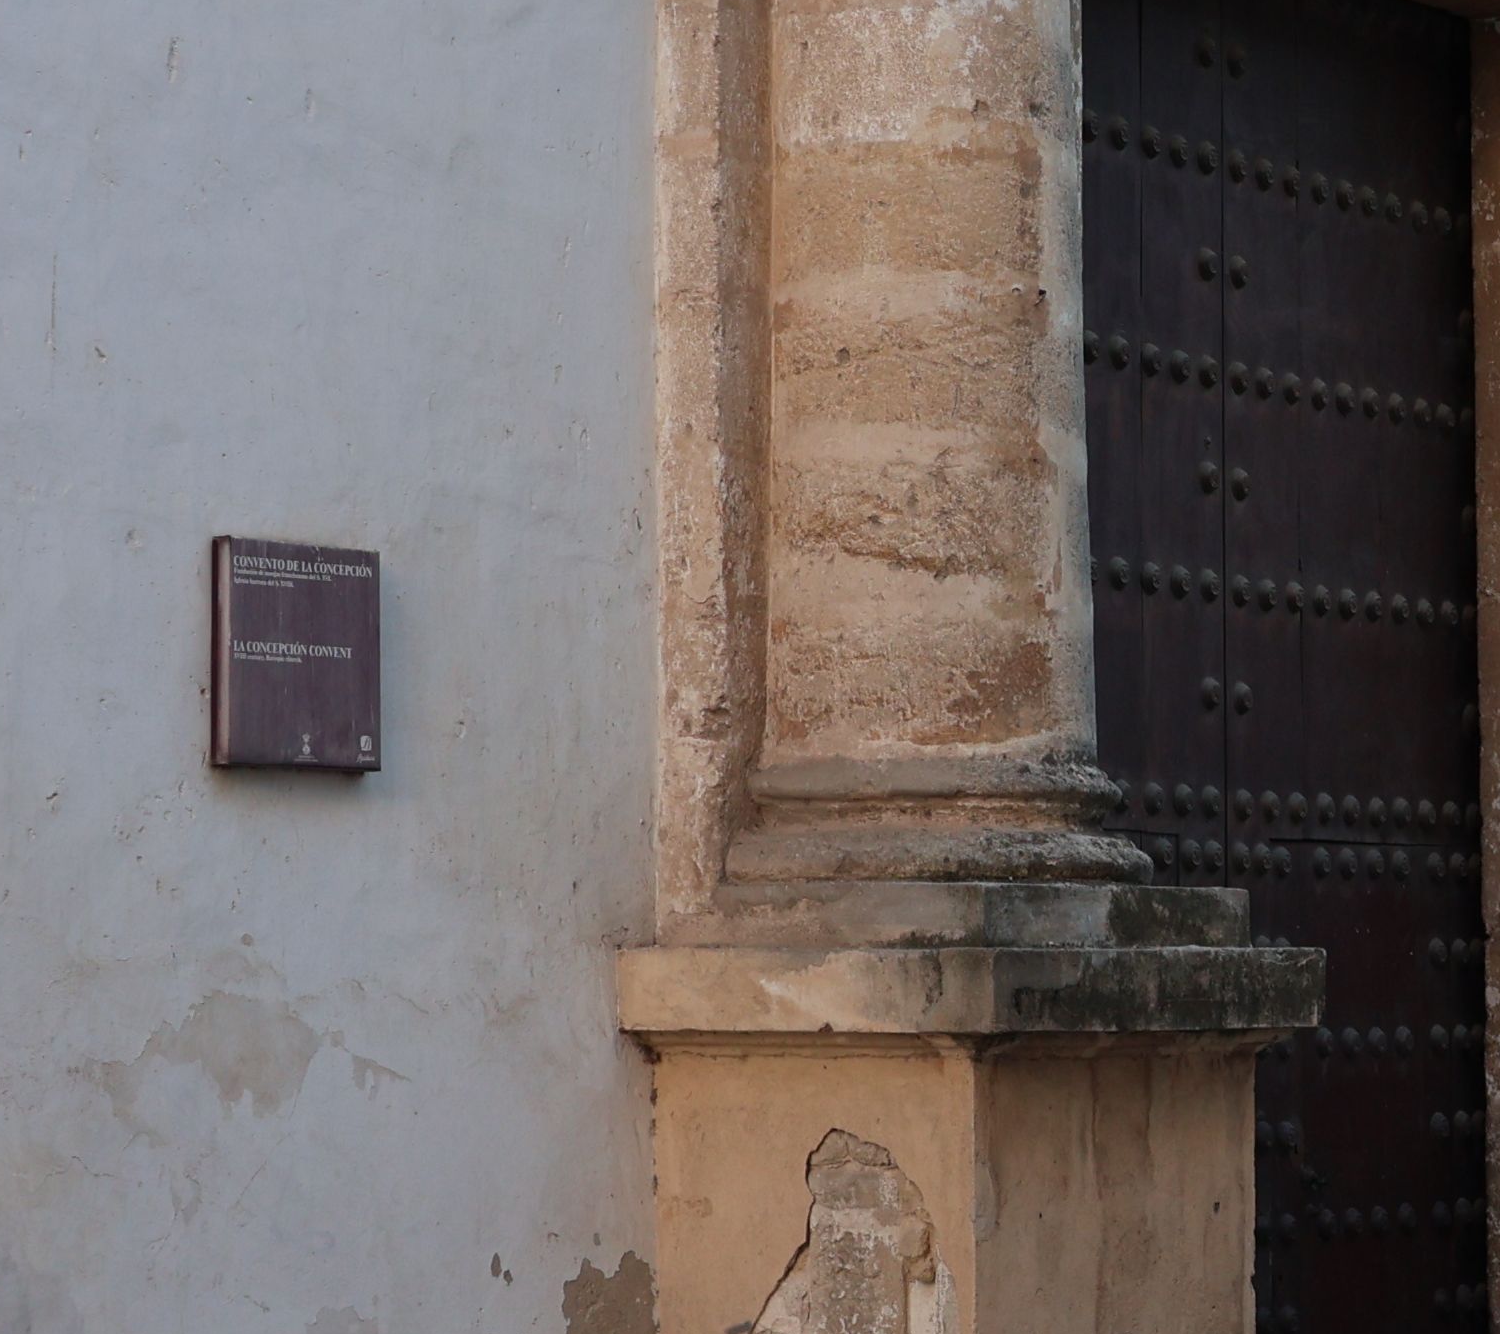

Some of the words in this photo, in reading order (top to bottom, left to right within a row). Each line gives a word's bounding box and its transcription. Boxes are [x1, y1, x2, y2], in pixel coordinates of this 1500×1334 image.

[233, 555, 285, 571] CONVENTO
[286, 560, 299, 572] DE
[301, 561, 312, 573] LA
[313, 562, 372, 578] CONCEPCIÓN
[233, 640, 245, 652] LA
[246, 641, 307, 655] CONCEPCIÓN
[309, 645, 352, 659] CONVENT
